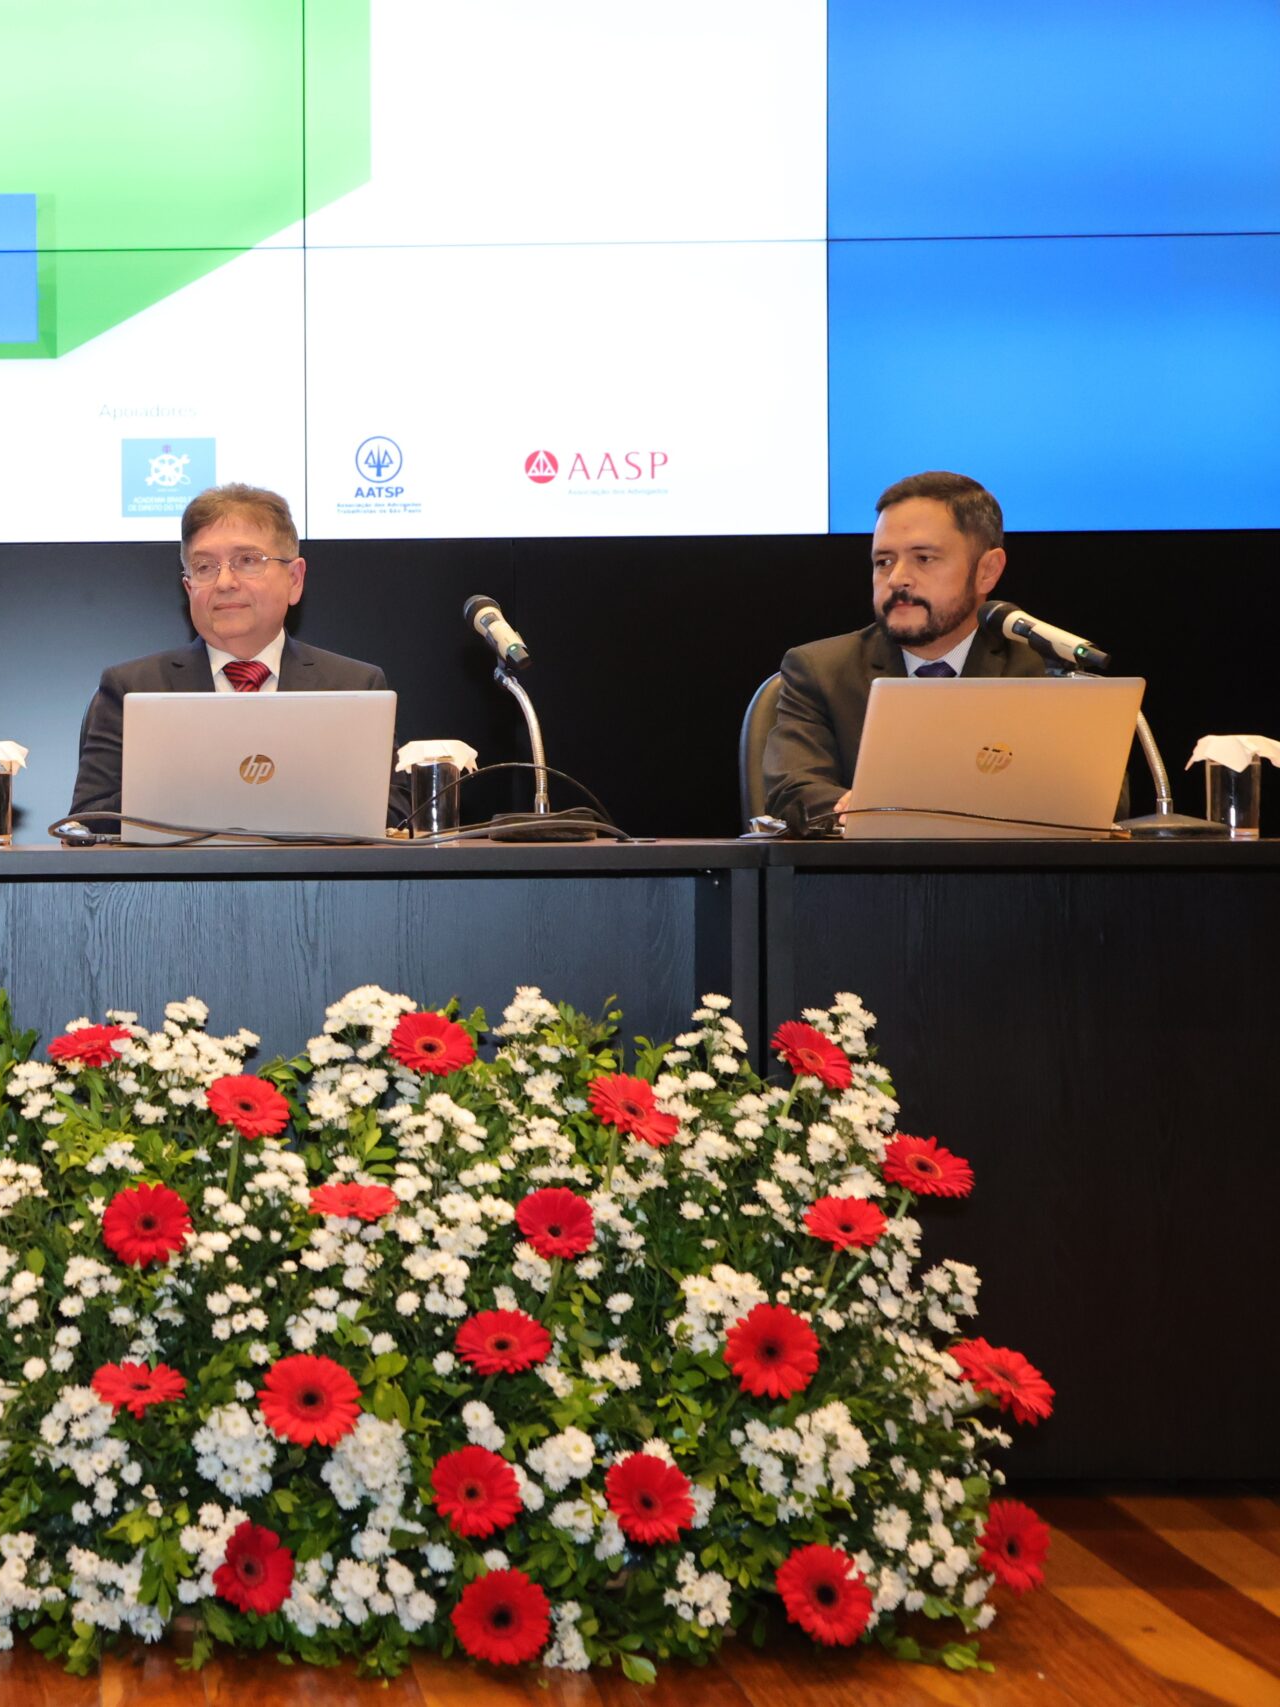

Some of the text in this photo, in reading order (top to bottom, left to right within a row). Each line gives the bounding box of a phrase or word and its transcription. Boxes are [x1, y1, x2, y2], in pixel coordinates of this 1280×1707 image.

[568, 451, 669, 481] AASP
[354, 486, 405, 499] AATSP
[243, 754, 272, 784] hp
